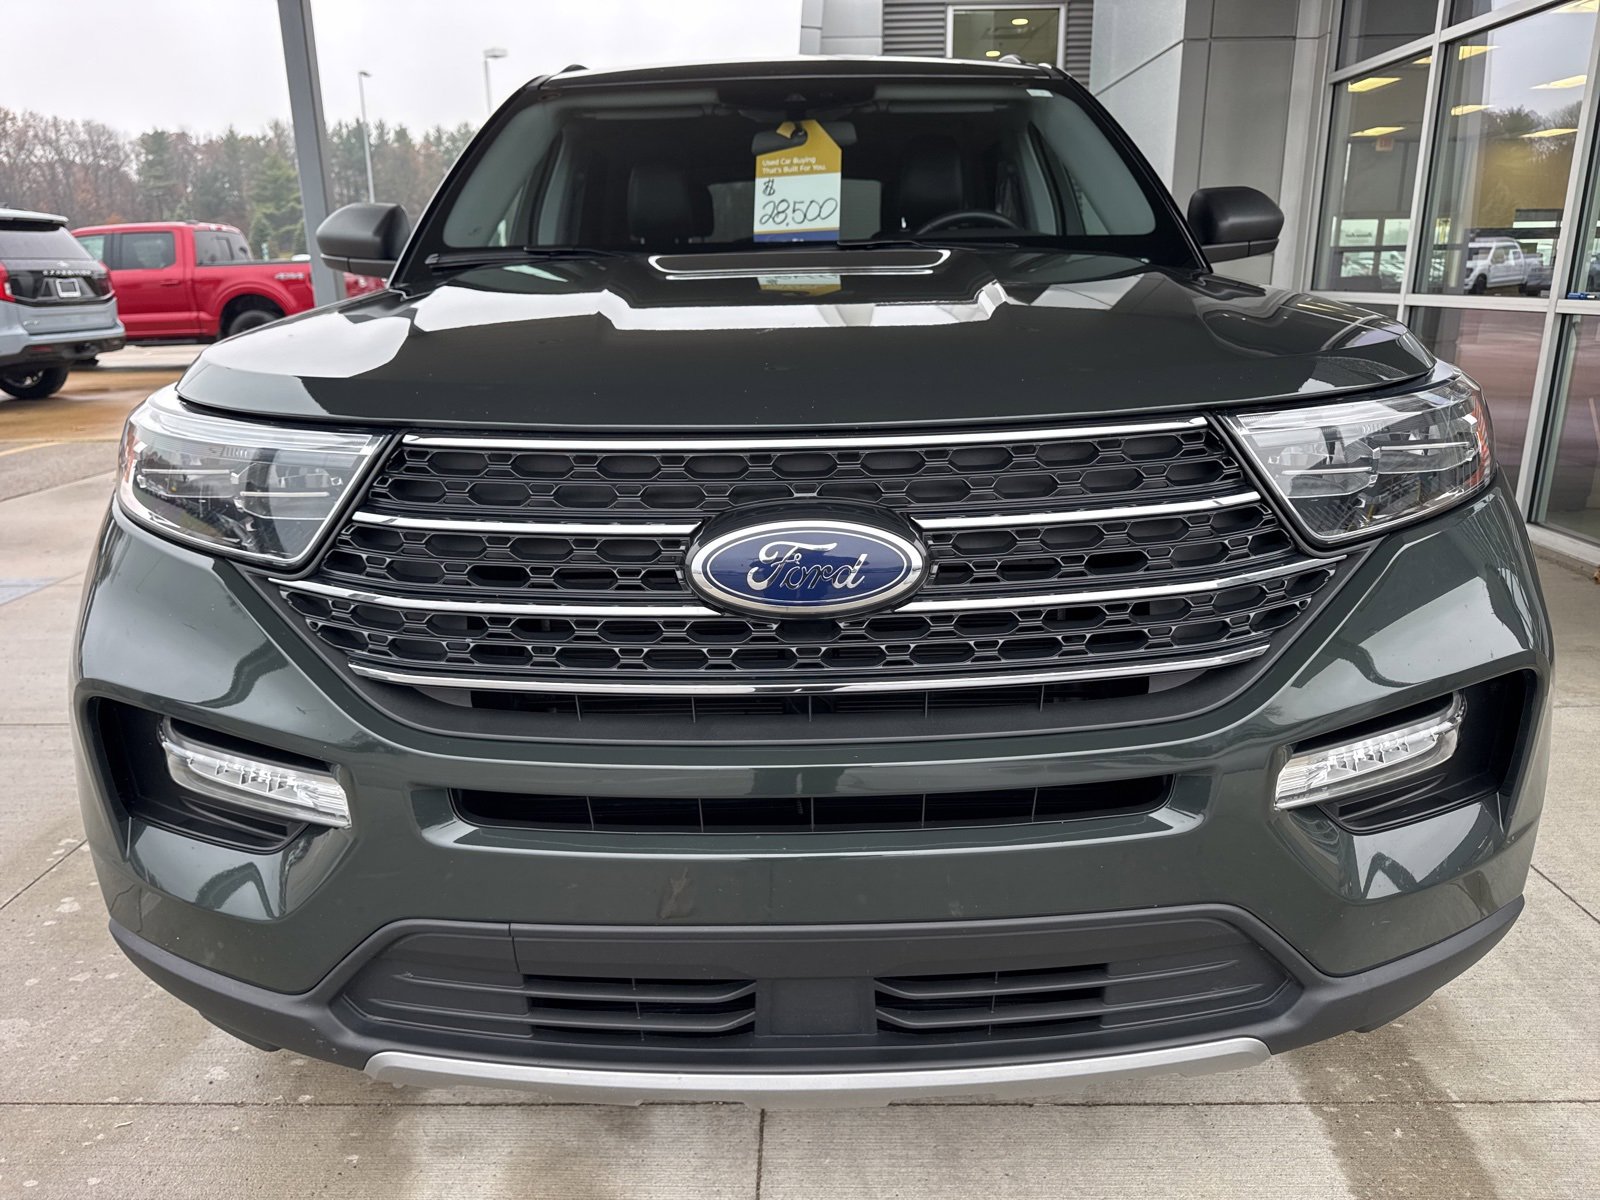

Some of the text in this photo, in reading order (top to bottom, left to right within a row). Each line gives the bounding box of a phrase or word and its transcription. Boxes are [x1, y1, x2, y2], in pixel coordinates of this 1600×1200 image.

[793, 157, 817, 165] Buying
[783, 165, 798, 173] Built
[747, 540, 868, 591] Ford
